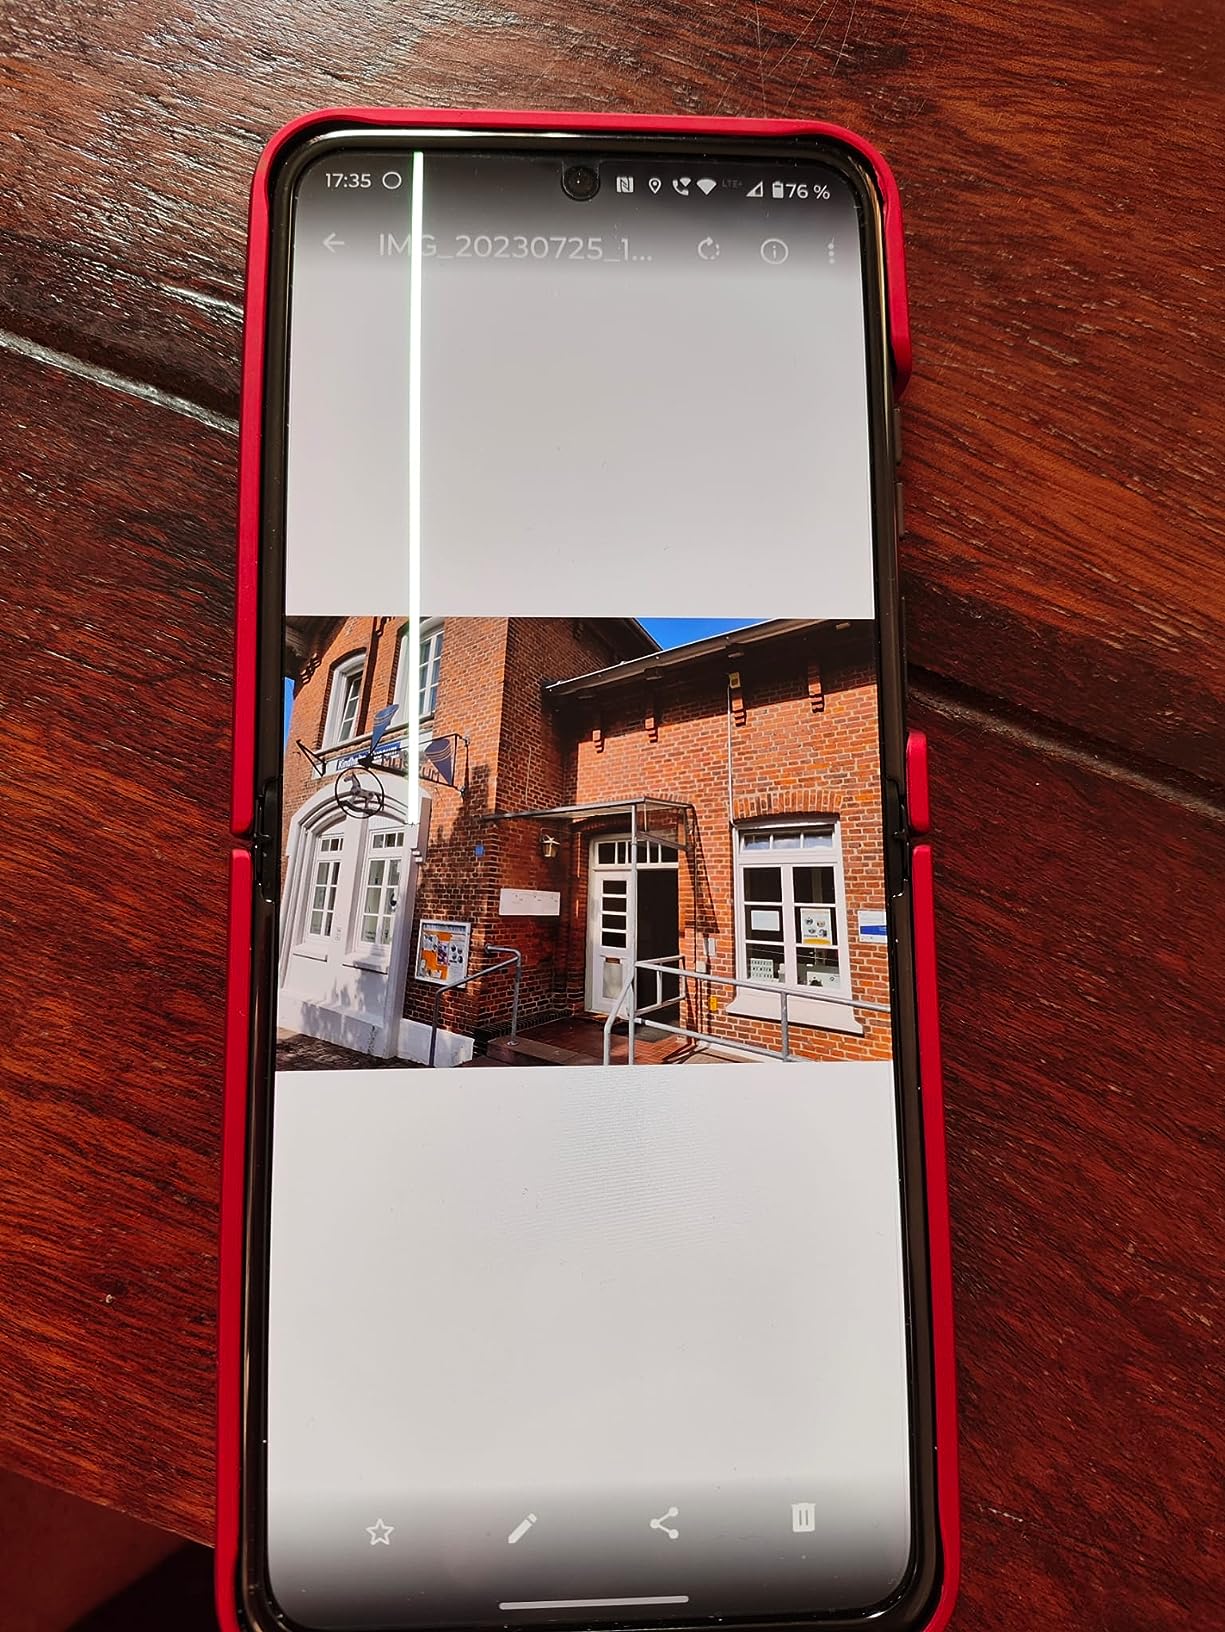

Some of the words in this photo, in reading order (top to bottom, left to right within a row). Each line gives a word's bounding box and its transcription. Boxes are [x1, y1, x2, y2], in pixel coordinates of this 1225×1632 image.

[325, 172, 372, 189] 17:35
[785, 183, 809, 199] 76
[813, 184, 831, 200] %
